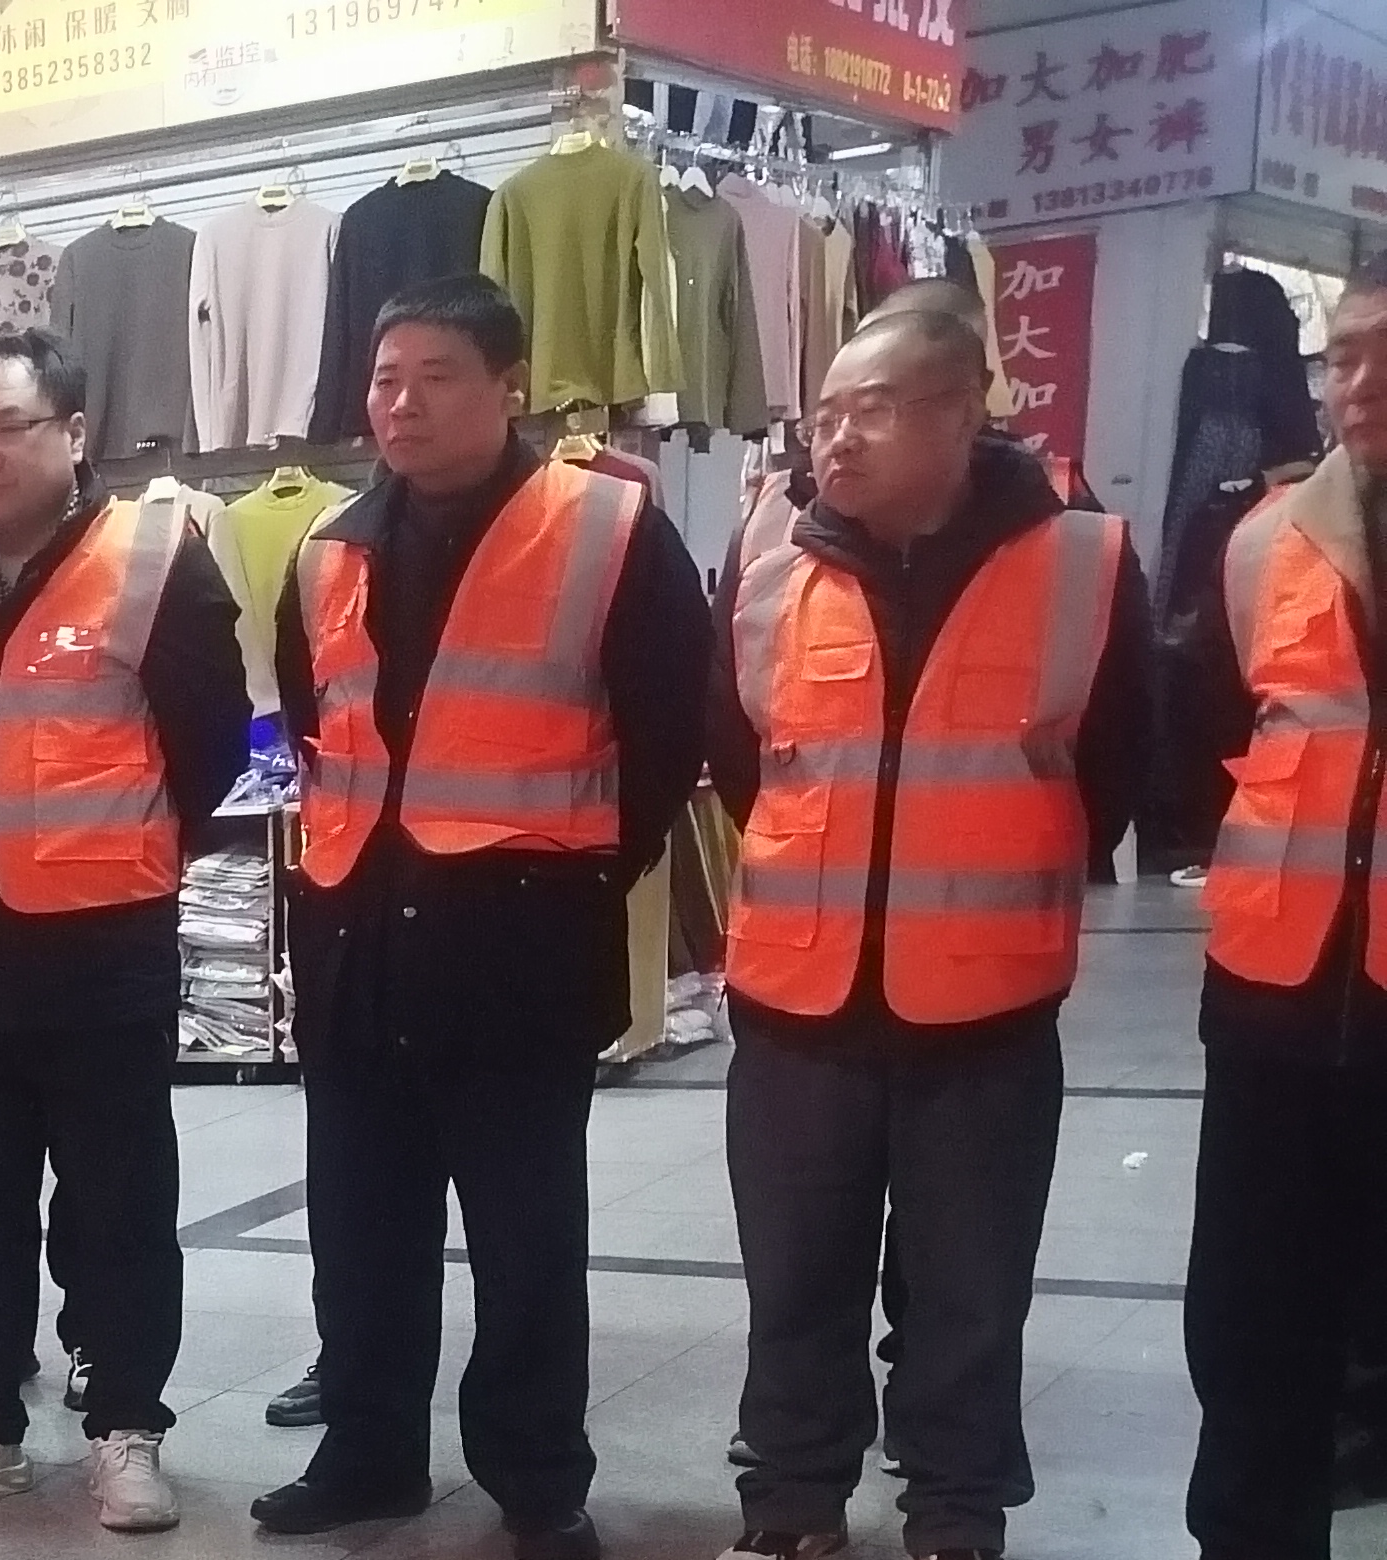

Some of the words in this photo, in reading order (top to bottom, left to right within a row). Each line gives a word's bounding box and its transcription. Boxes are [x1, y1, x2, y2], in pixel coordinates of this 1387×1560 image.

[65, 6, 117, 42] 保暖
[960, 29, 1217, 112] 加大加肥
[1016, 97, 1209, 176] 男女裤
[992, 260, 1065, 453] 加大加
